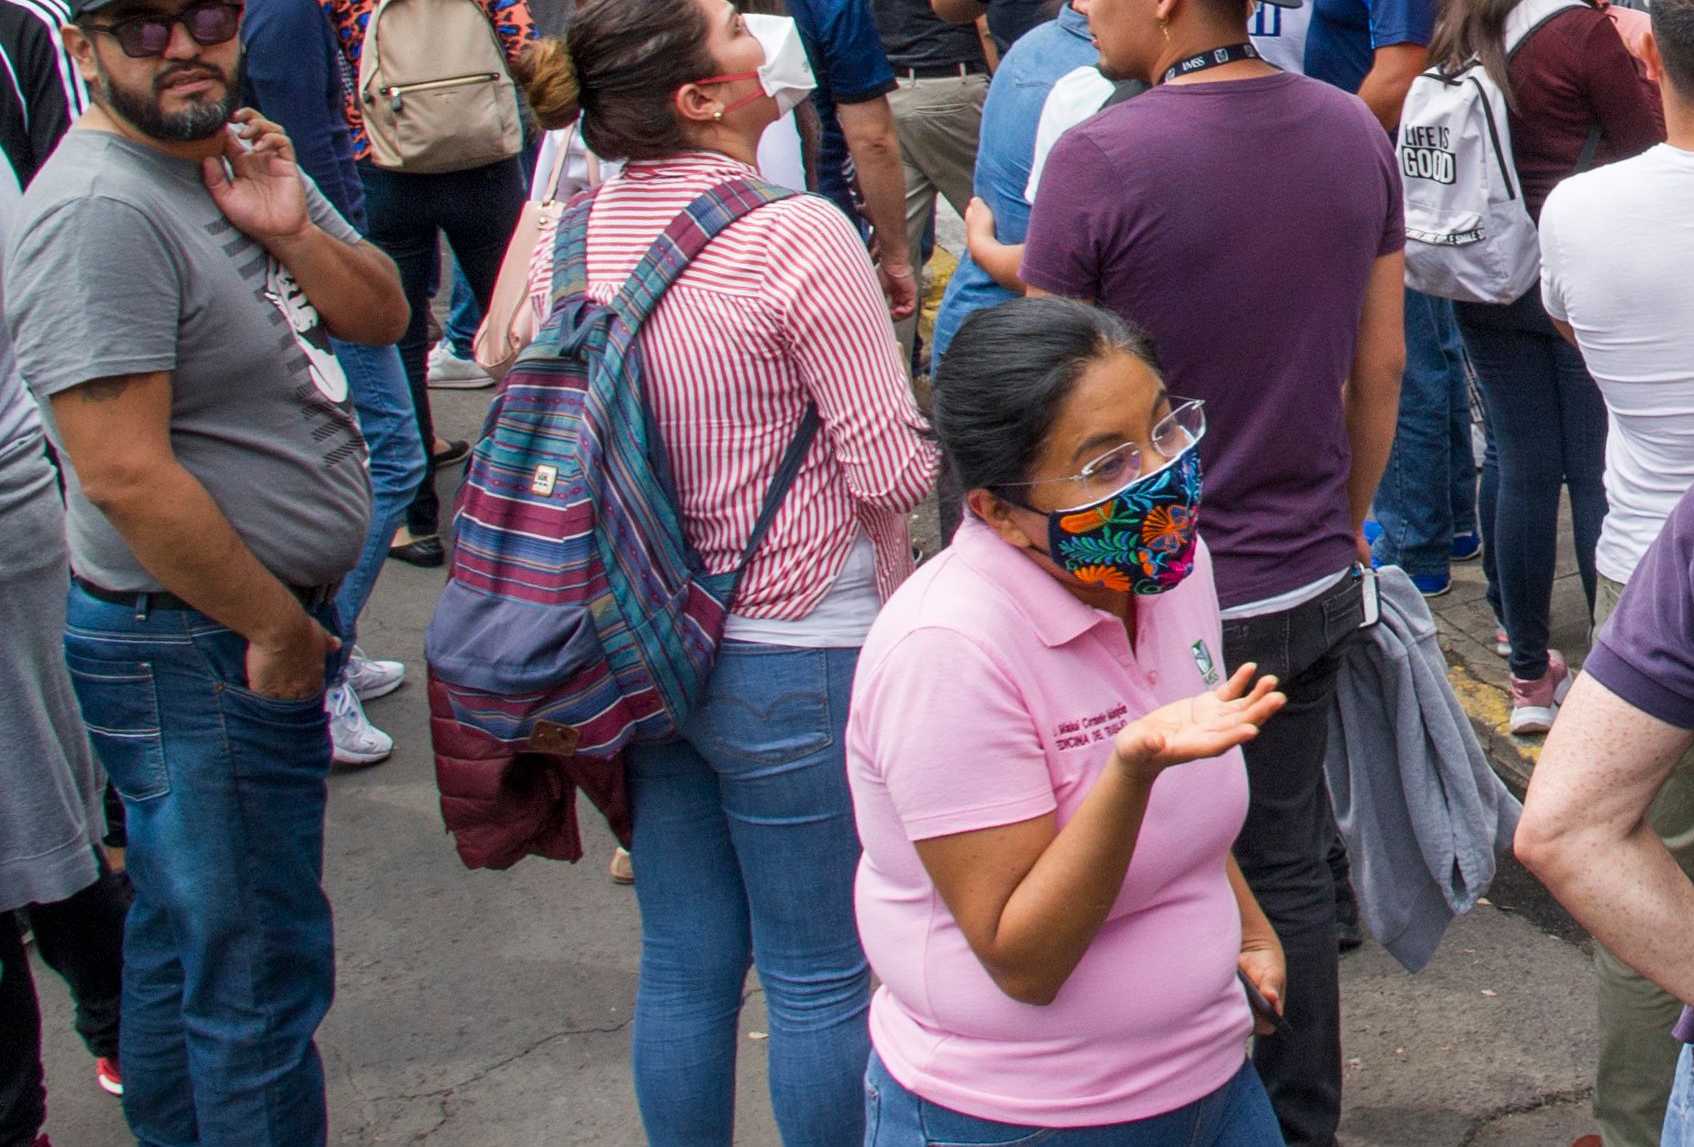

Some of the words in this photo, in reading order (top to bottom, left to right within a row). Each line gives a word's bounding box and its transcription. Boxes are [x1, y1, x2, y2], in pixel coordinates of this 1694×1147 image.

[1181, 56, 1205, 71] IMSS
[1404, 124, 1436, 147] LIFE
[1439, 126, 1450, 149] IS
[1403, 147, 1455, 184] GOOD
